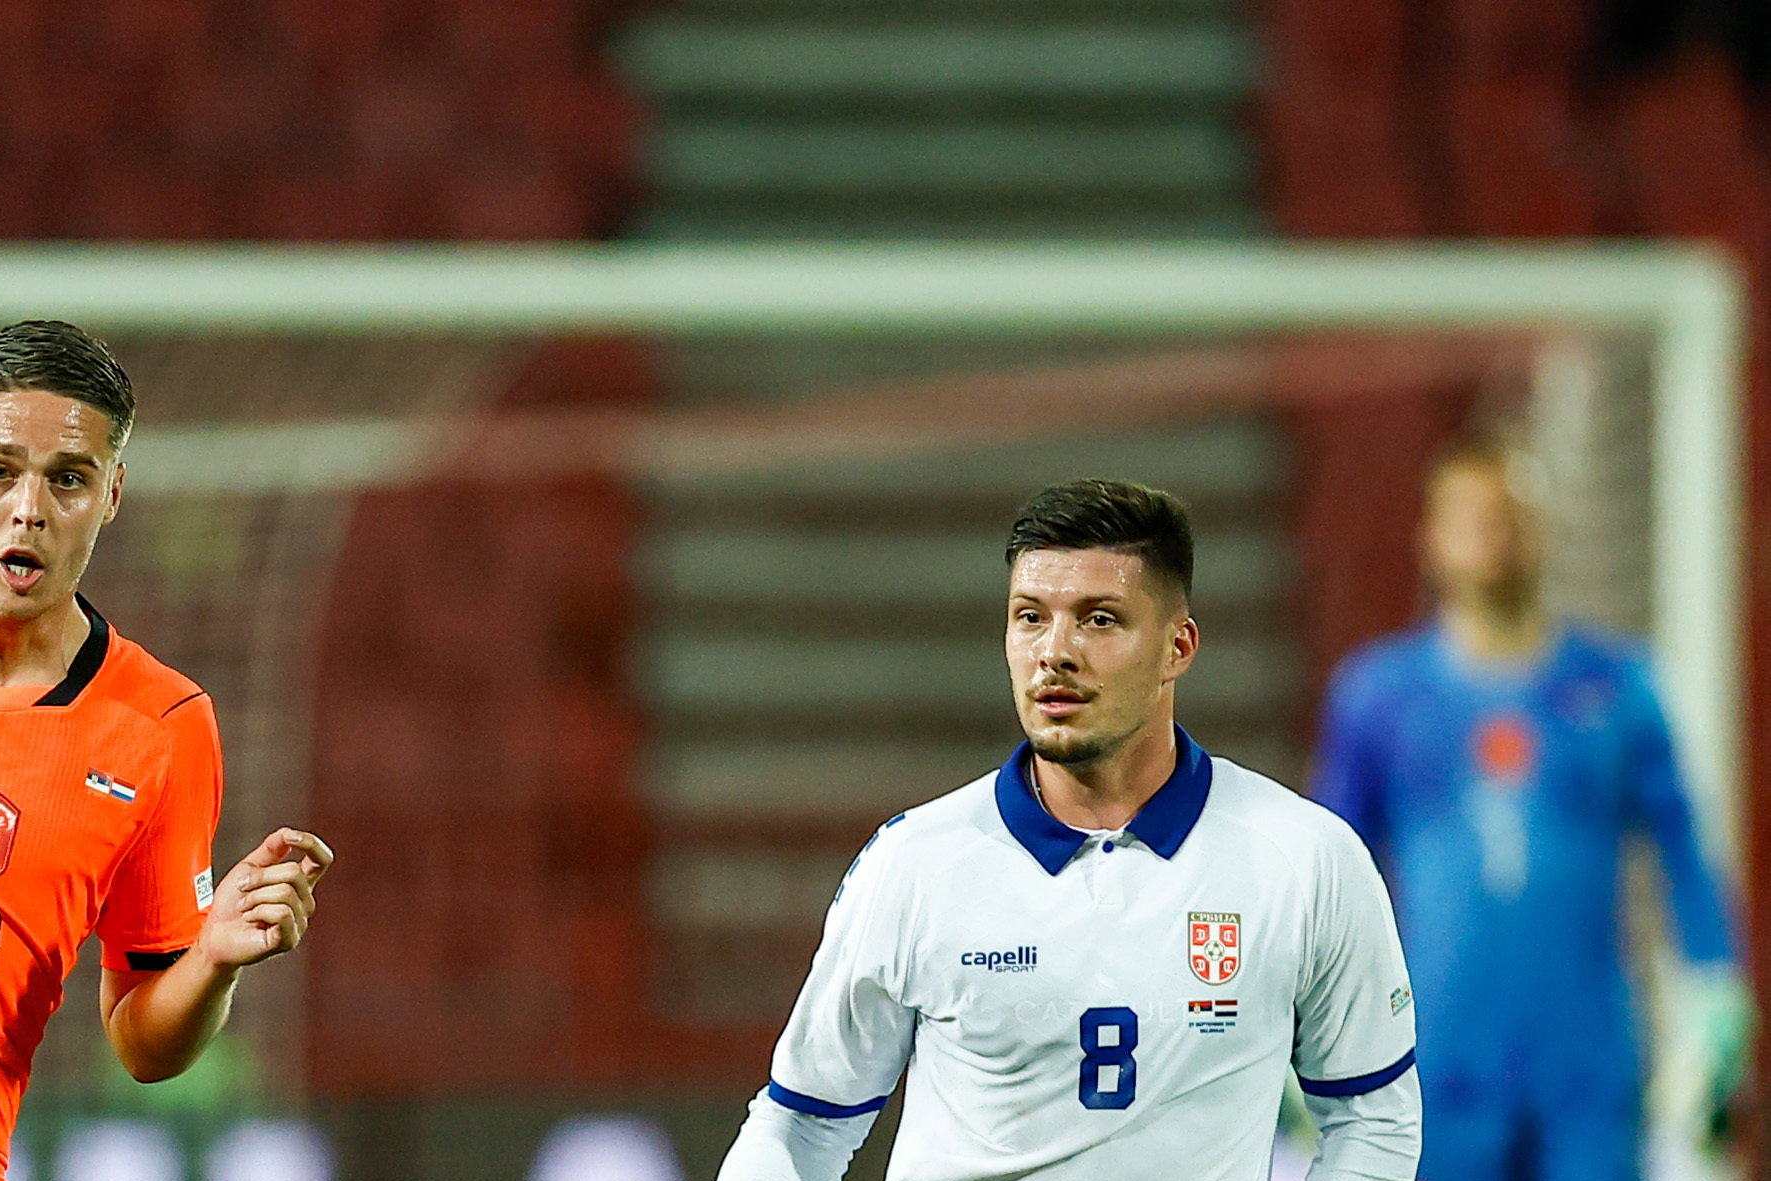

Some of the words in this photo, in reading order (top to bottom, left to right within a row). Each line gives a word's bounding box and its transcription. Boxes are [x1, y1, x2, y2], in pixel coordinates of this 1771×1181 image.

[960, 945, 1037, 971] capelli
[994, 965, 1037, 974] SPORT
[1077, 1005, 1139, 1111] 8
